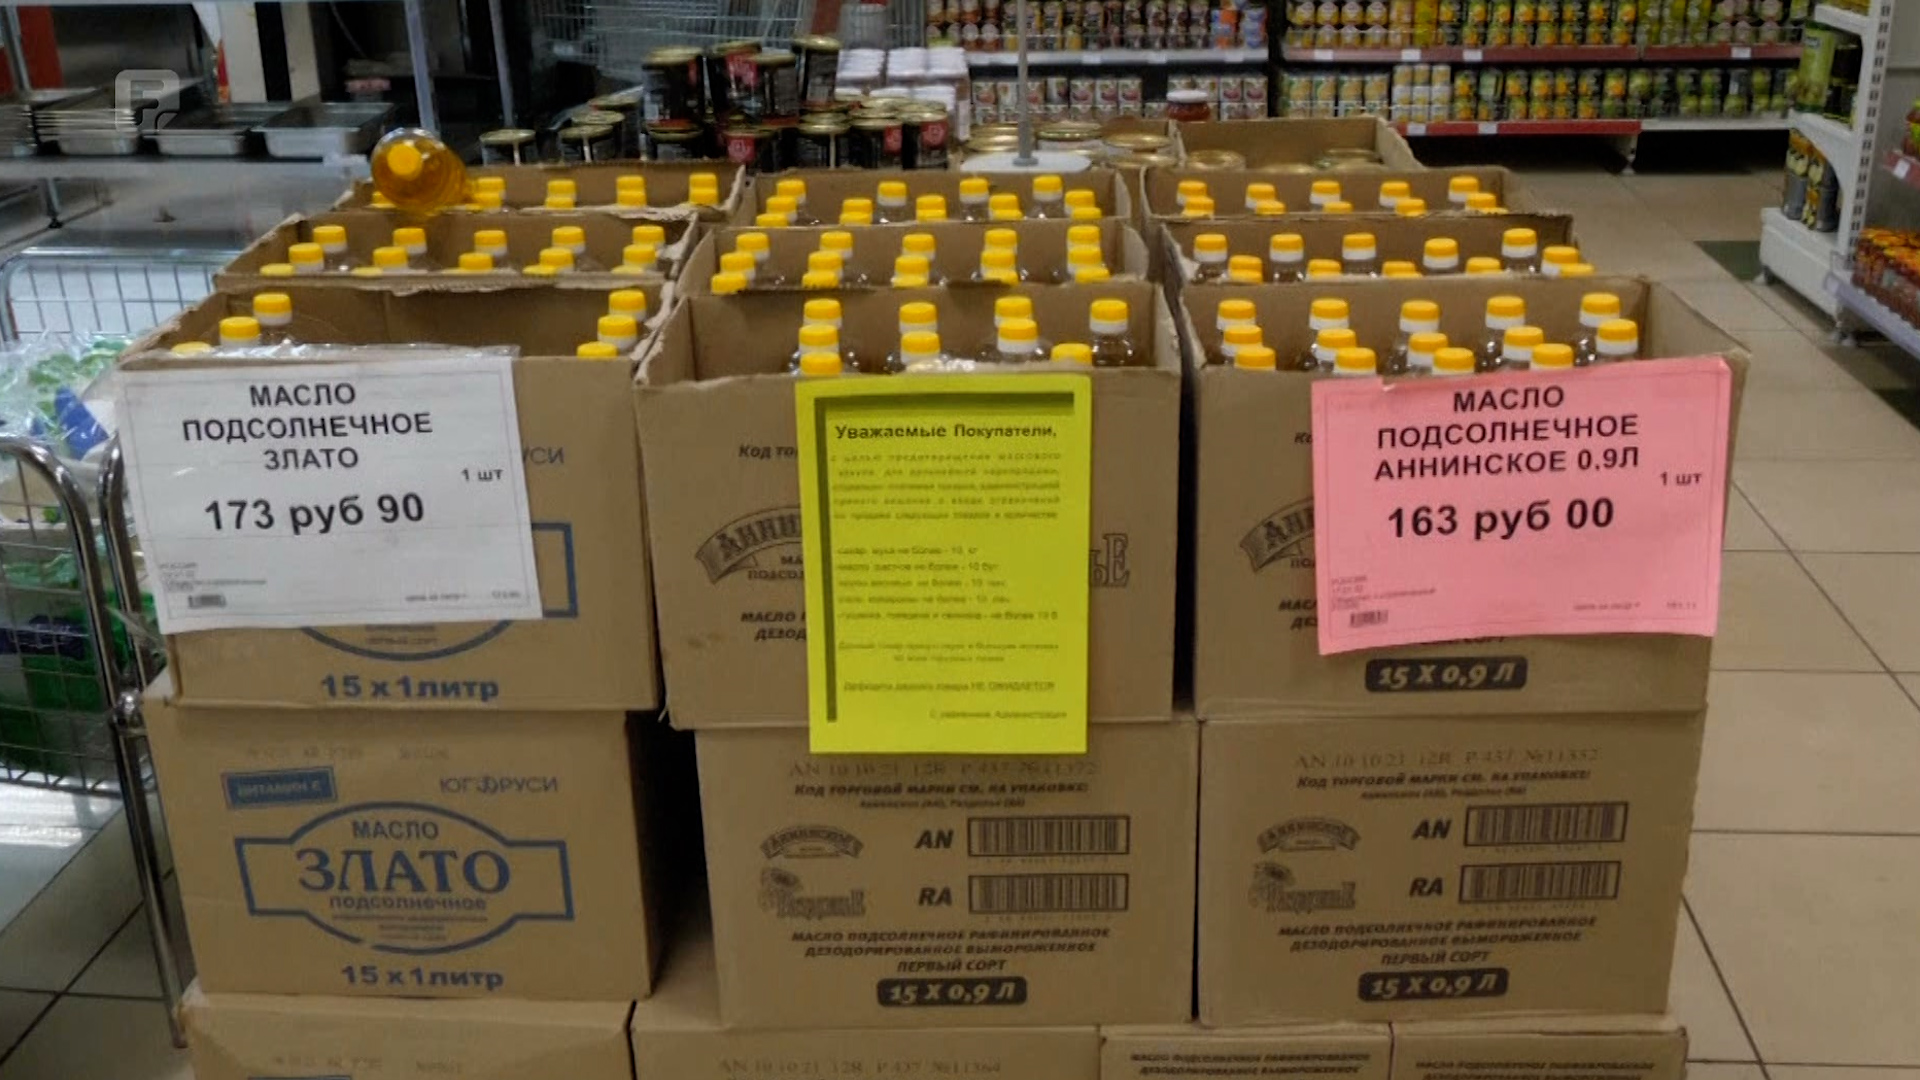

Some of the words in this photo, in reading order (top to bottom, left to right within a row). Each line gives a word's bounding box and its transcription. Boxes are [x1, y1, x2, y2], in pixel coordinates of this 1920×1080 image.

[249, 383, 356, 408] МАСЛО
[1453, 385, 1565, 412] МАСЛО
[182, 412, 433, 443] ПОДСОЛНЕЧНОЕ
[835, 425, 947, 439] Уважаемые
[1377, 414, 1639, 450] ПОДСОЛНЕЧНОЕ
[264, 447, 359, 470] ЗЛАТО
[1375, 451, 1567, 481] АННИНСКОЕ
[461, 469, 470, 482] 1
[478, 468, 503, 483] шт
[1660, 473, 1669, 486] 1
[1675, 472, 1702, 486] шт
[205, 500, 275, 531] 173
[289, 495, 363, 534] руб
[378, 492, 425, 524] 90
[1388, 506, 1458, 538] 163
[1474, 500, 1550, 541] руб
[1566, 498, 1614, 529] 00
[322, 675, 363, 697] 15
[1378, 666, 1409, 689] 15
[1443, 663, 1487, 688] 0,9
[1493, 663, 1516, 683] Л
[352, 820, 439, 840] МАСЛО
[914, 830, 954, 849] AN
[1411, 819, 1452, 840] AN
[296, 849, 510, 894] ЗЛАТО
[918, 887, 952, 906] RA
[1409, 877, 1444, 897] RA
[897, 959, 963, 973] ПЕРВЫЙ
[966, 959, 1008, 971] СОРТ
[1380, 950, 1446, 966] ПЕРВЫЙ
[1450, 949, 1491, 963] СОРТ
[341, 966, 377, 985] 15
[1371, 980, 1398, 999] 15
[1476, 973, 1497, 990] Л
[889, 986, 917, 1004] 15
[947, 983, 988, 1004] 0,9
[995, 983, 1016, 999] Л
